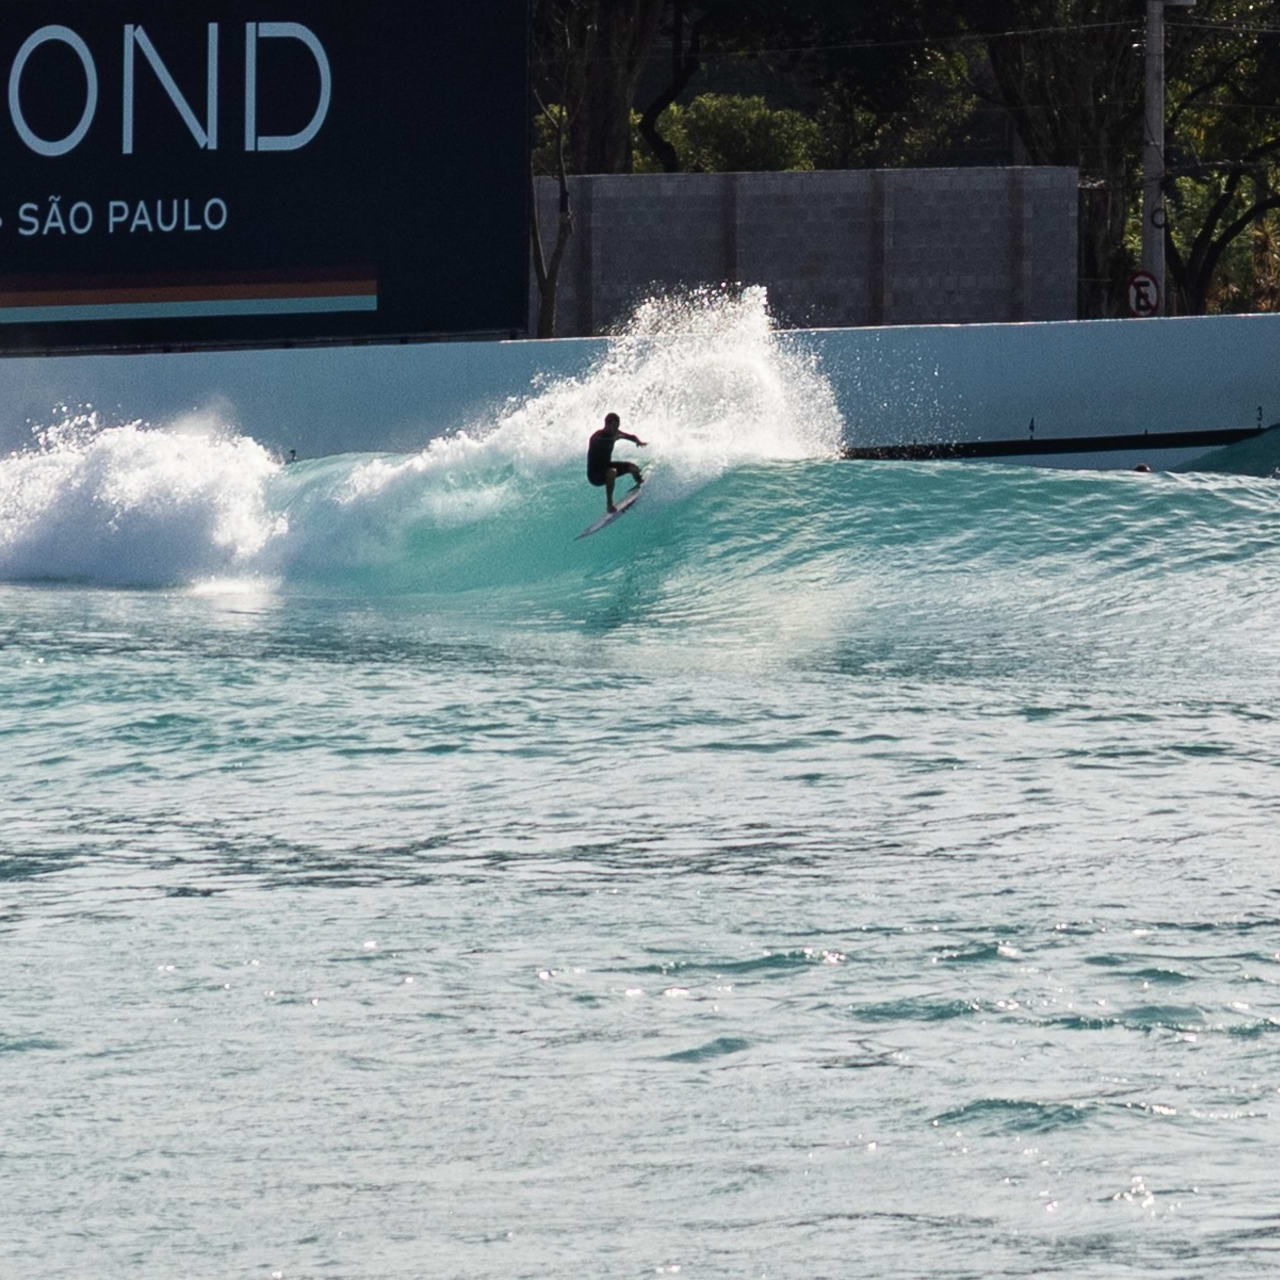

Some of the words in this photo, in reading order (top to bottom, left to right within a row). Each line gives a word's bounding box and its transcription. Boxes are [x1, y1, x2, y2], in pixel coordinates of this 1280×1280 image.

[8, 21, 332, 157] OND
[18, 195, 93, 236] SÃO
[108, 197, 228, 233] PAULO
